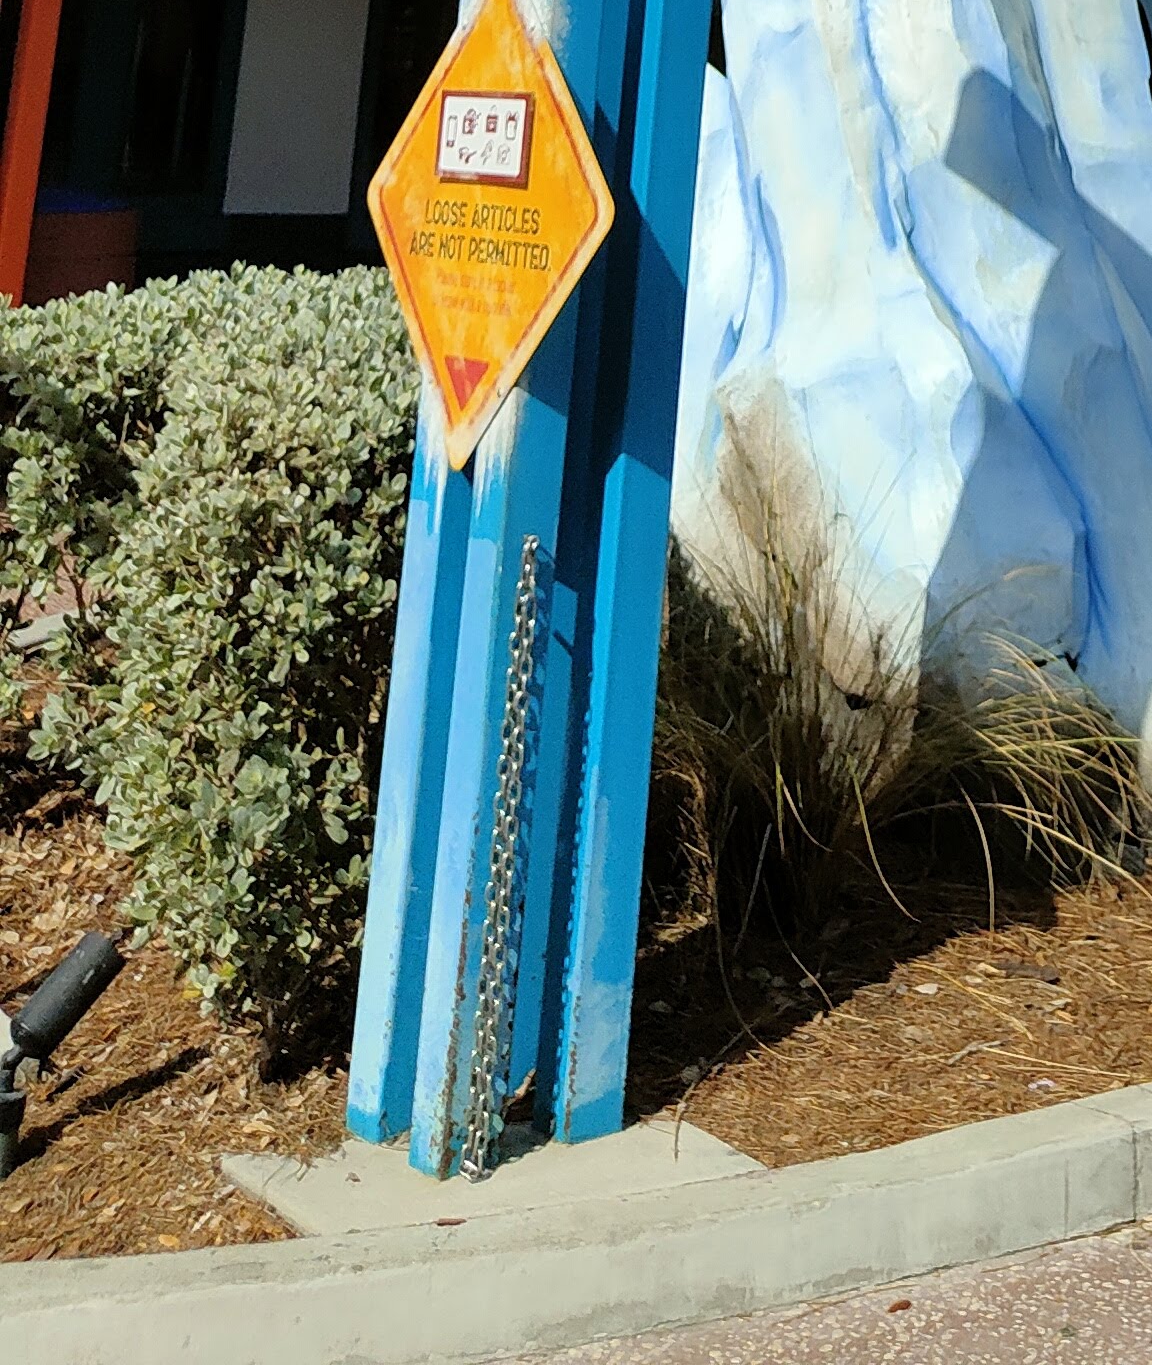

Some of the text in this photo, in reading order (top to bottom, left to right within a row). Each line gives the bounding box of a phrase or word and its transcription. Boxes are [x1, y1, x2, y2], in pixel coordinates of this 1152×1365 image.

[424, 198, 542, 236] LOOSE ARTICLES
[409, 230, 552, 272] ARE NOT PERMITTED.
